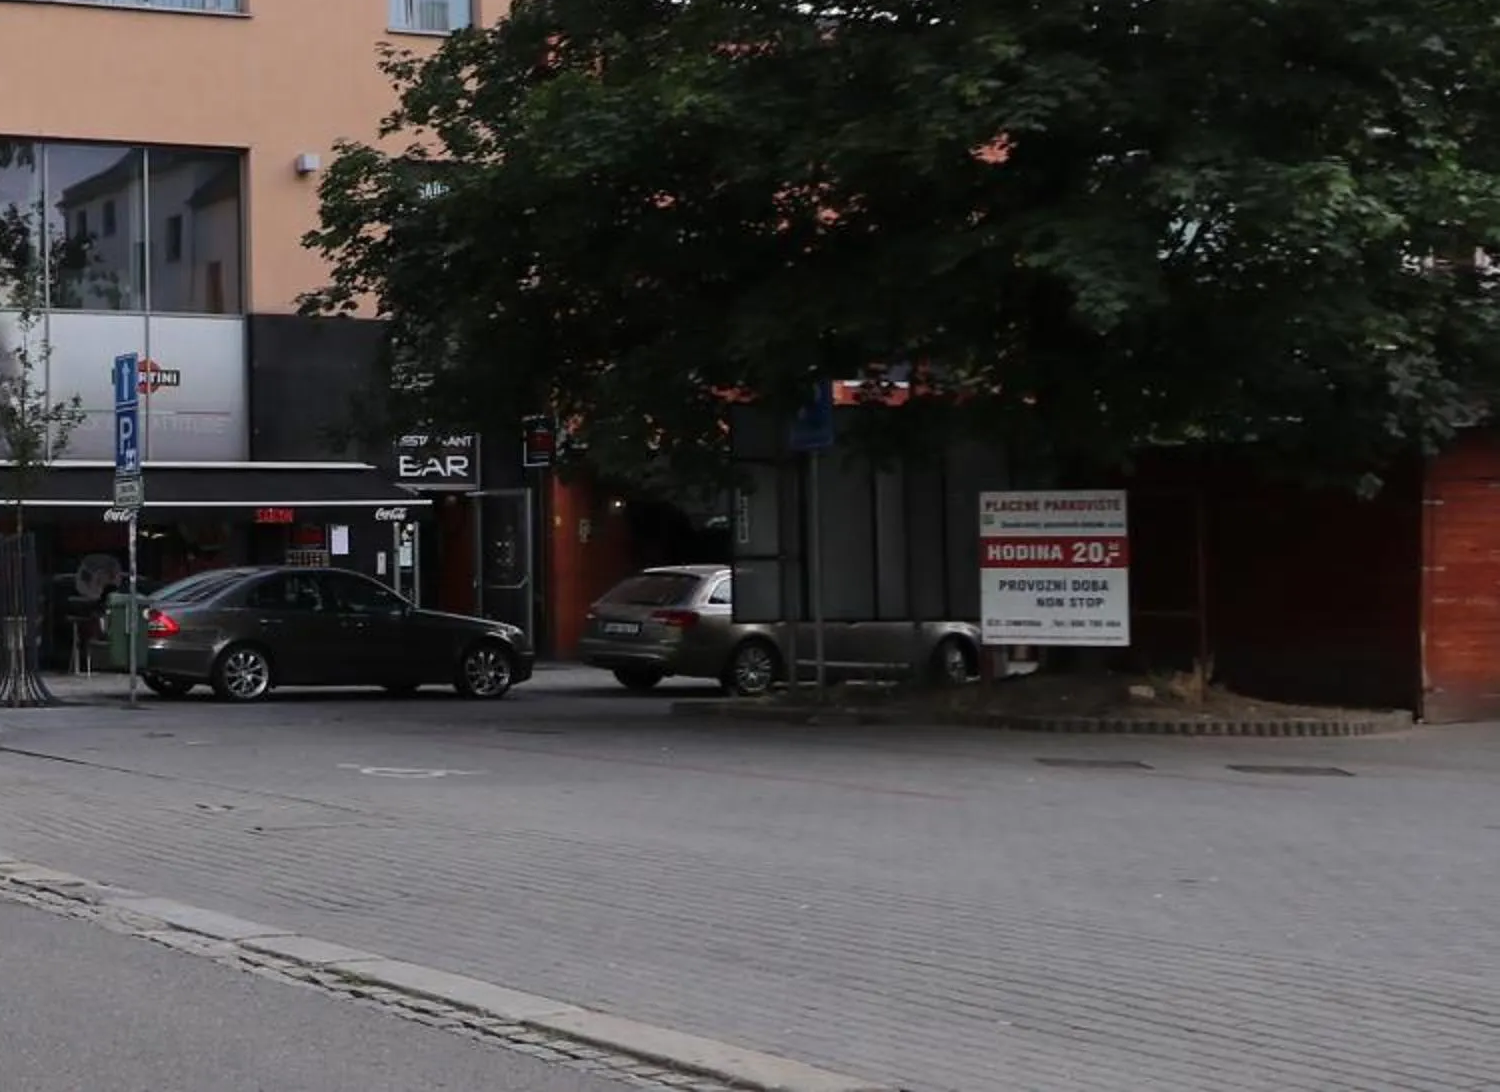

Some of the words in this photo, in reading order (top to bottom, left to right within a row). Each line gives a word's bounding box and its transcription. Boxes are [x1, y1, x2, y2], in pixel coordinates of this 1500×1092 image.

[119, 417, 133, 455] P
[987, 544, 1063, 561] HODINA
[998, 578, 1067, 592] PROVOZNÍ
[1071, 579, 1109, 592] DOBA
[1036, 597, 1065, 608] NON
[1069, 597, 1105, 608] STOP
